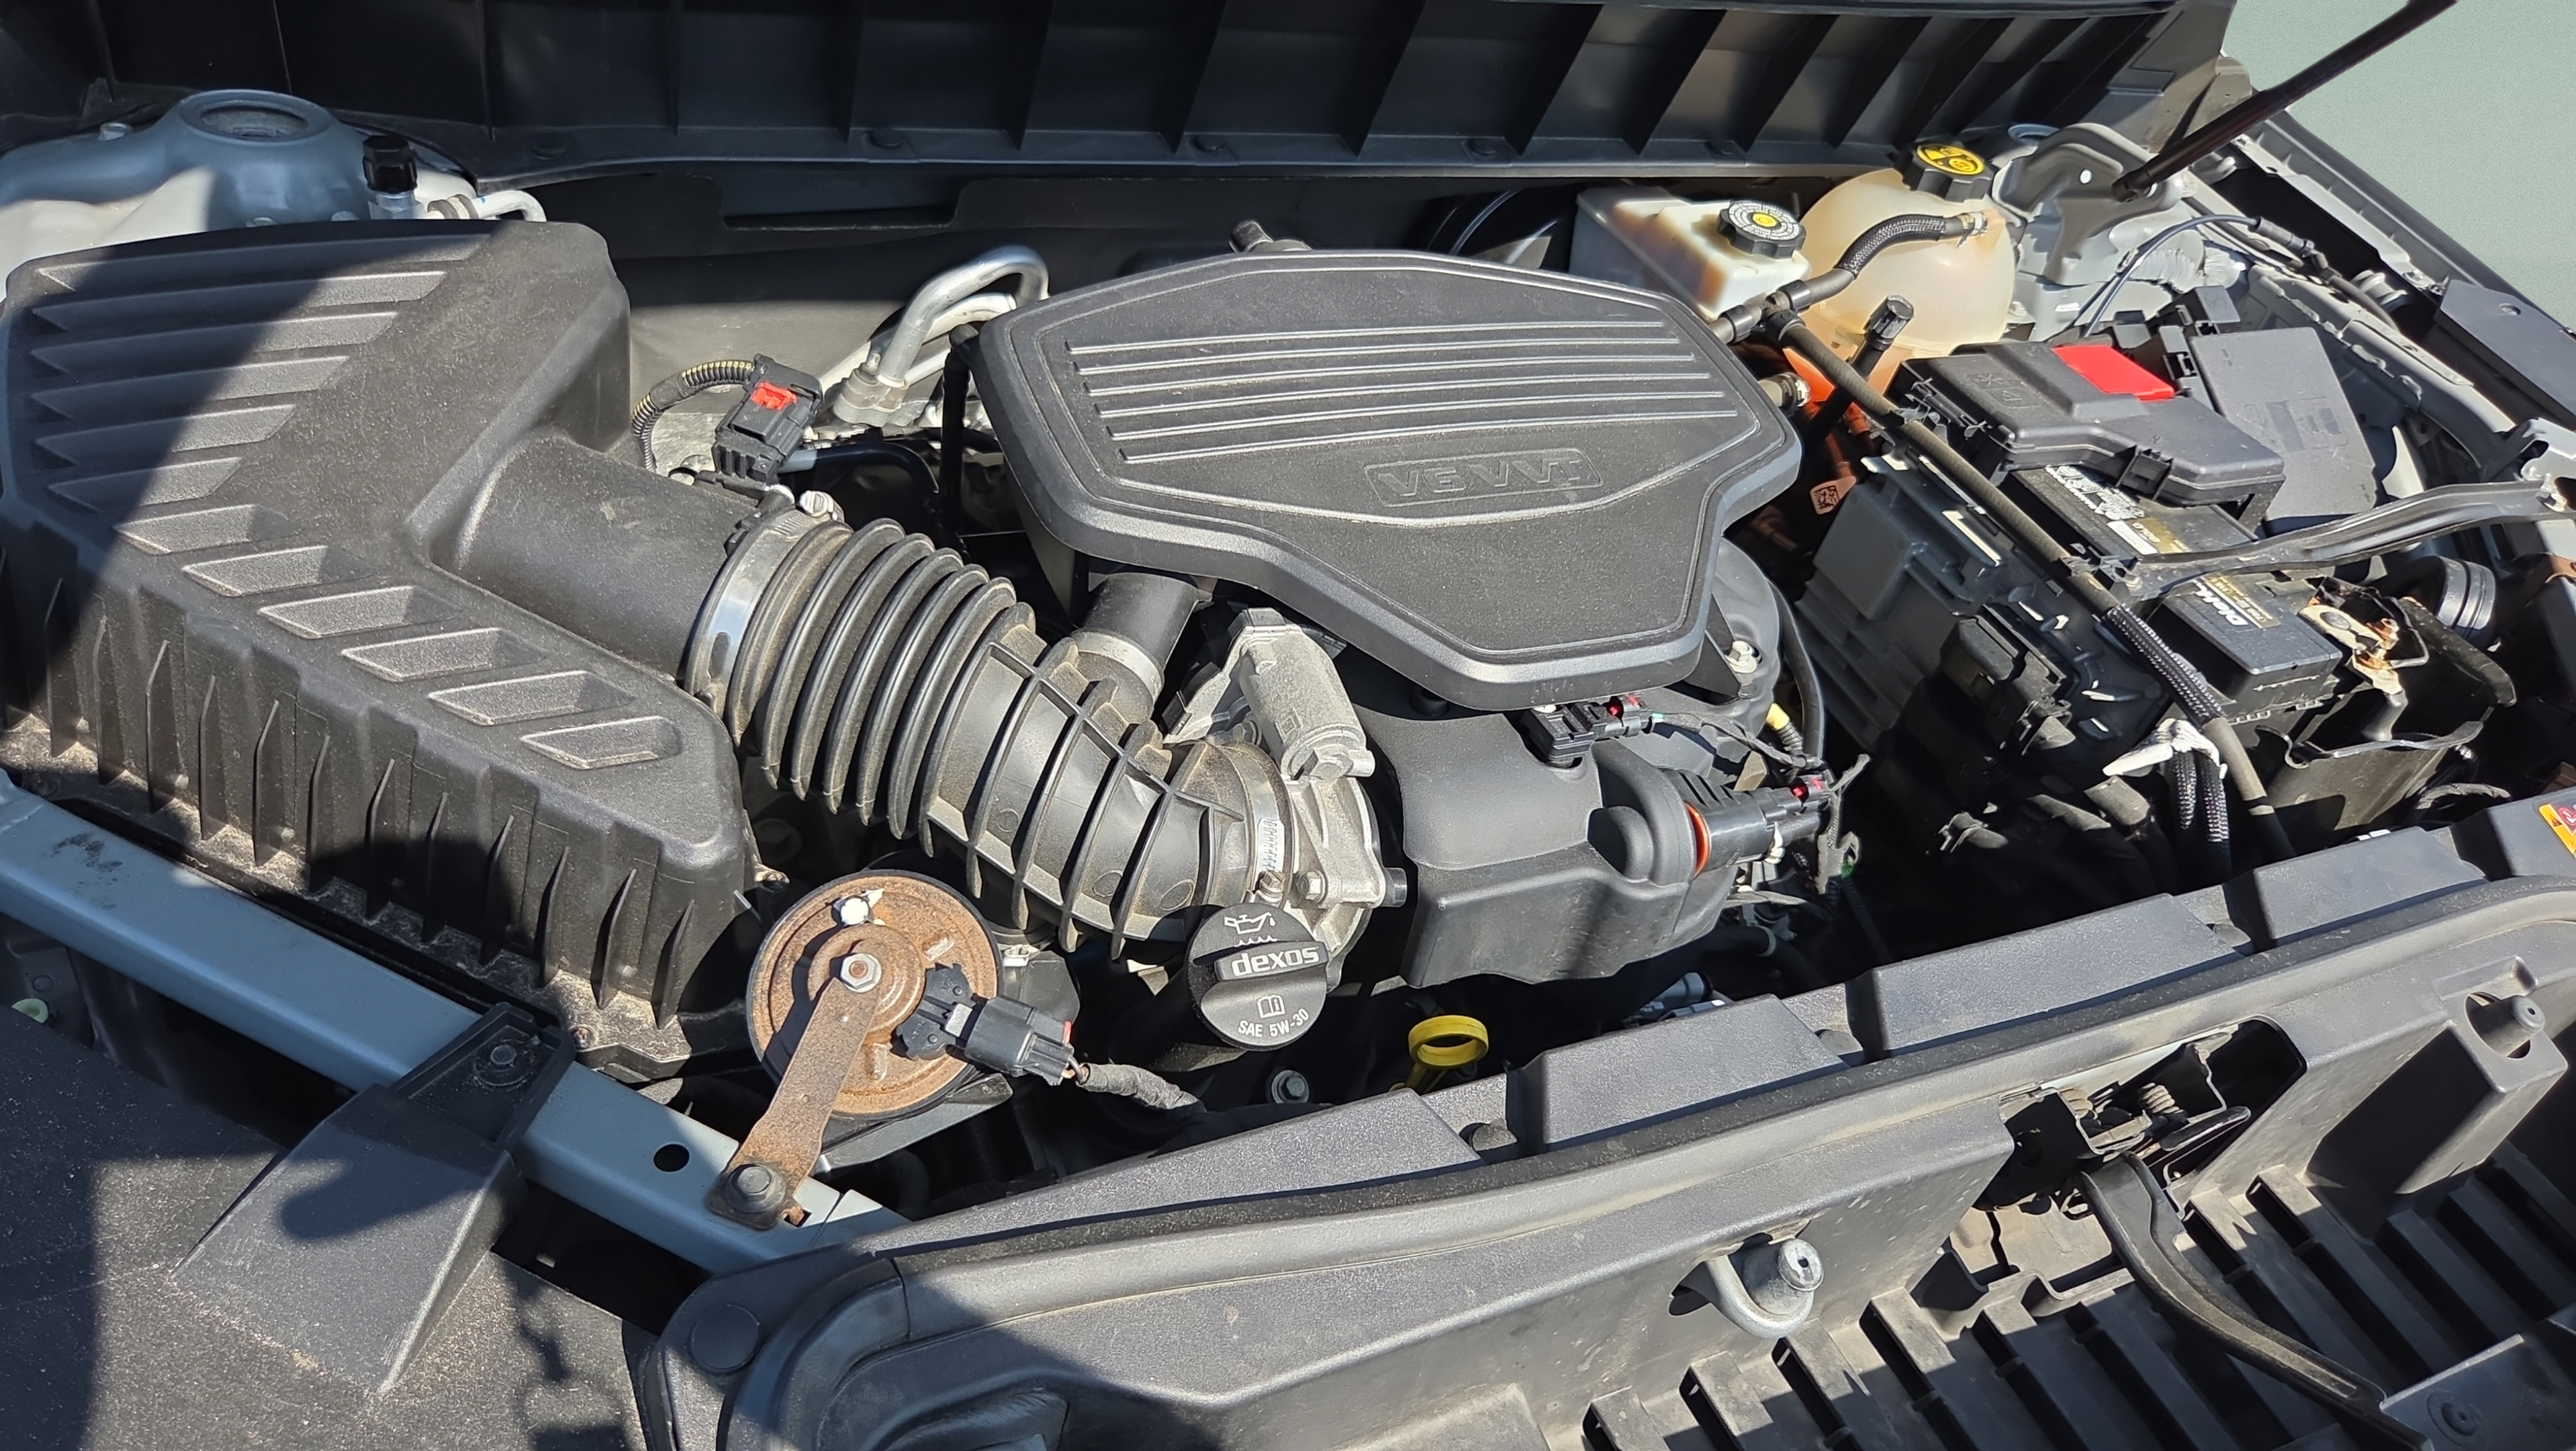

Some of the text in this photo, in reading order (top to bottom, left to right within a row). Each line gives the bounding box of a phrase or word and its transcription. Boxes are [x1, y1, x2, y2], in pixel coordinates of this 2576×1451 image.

[1377, 466, 1467, 496] V6
[1231, 946, 1320, 977] dexos
[1238, 1008, 1309, 1038] SAE 5W-30
